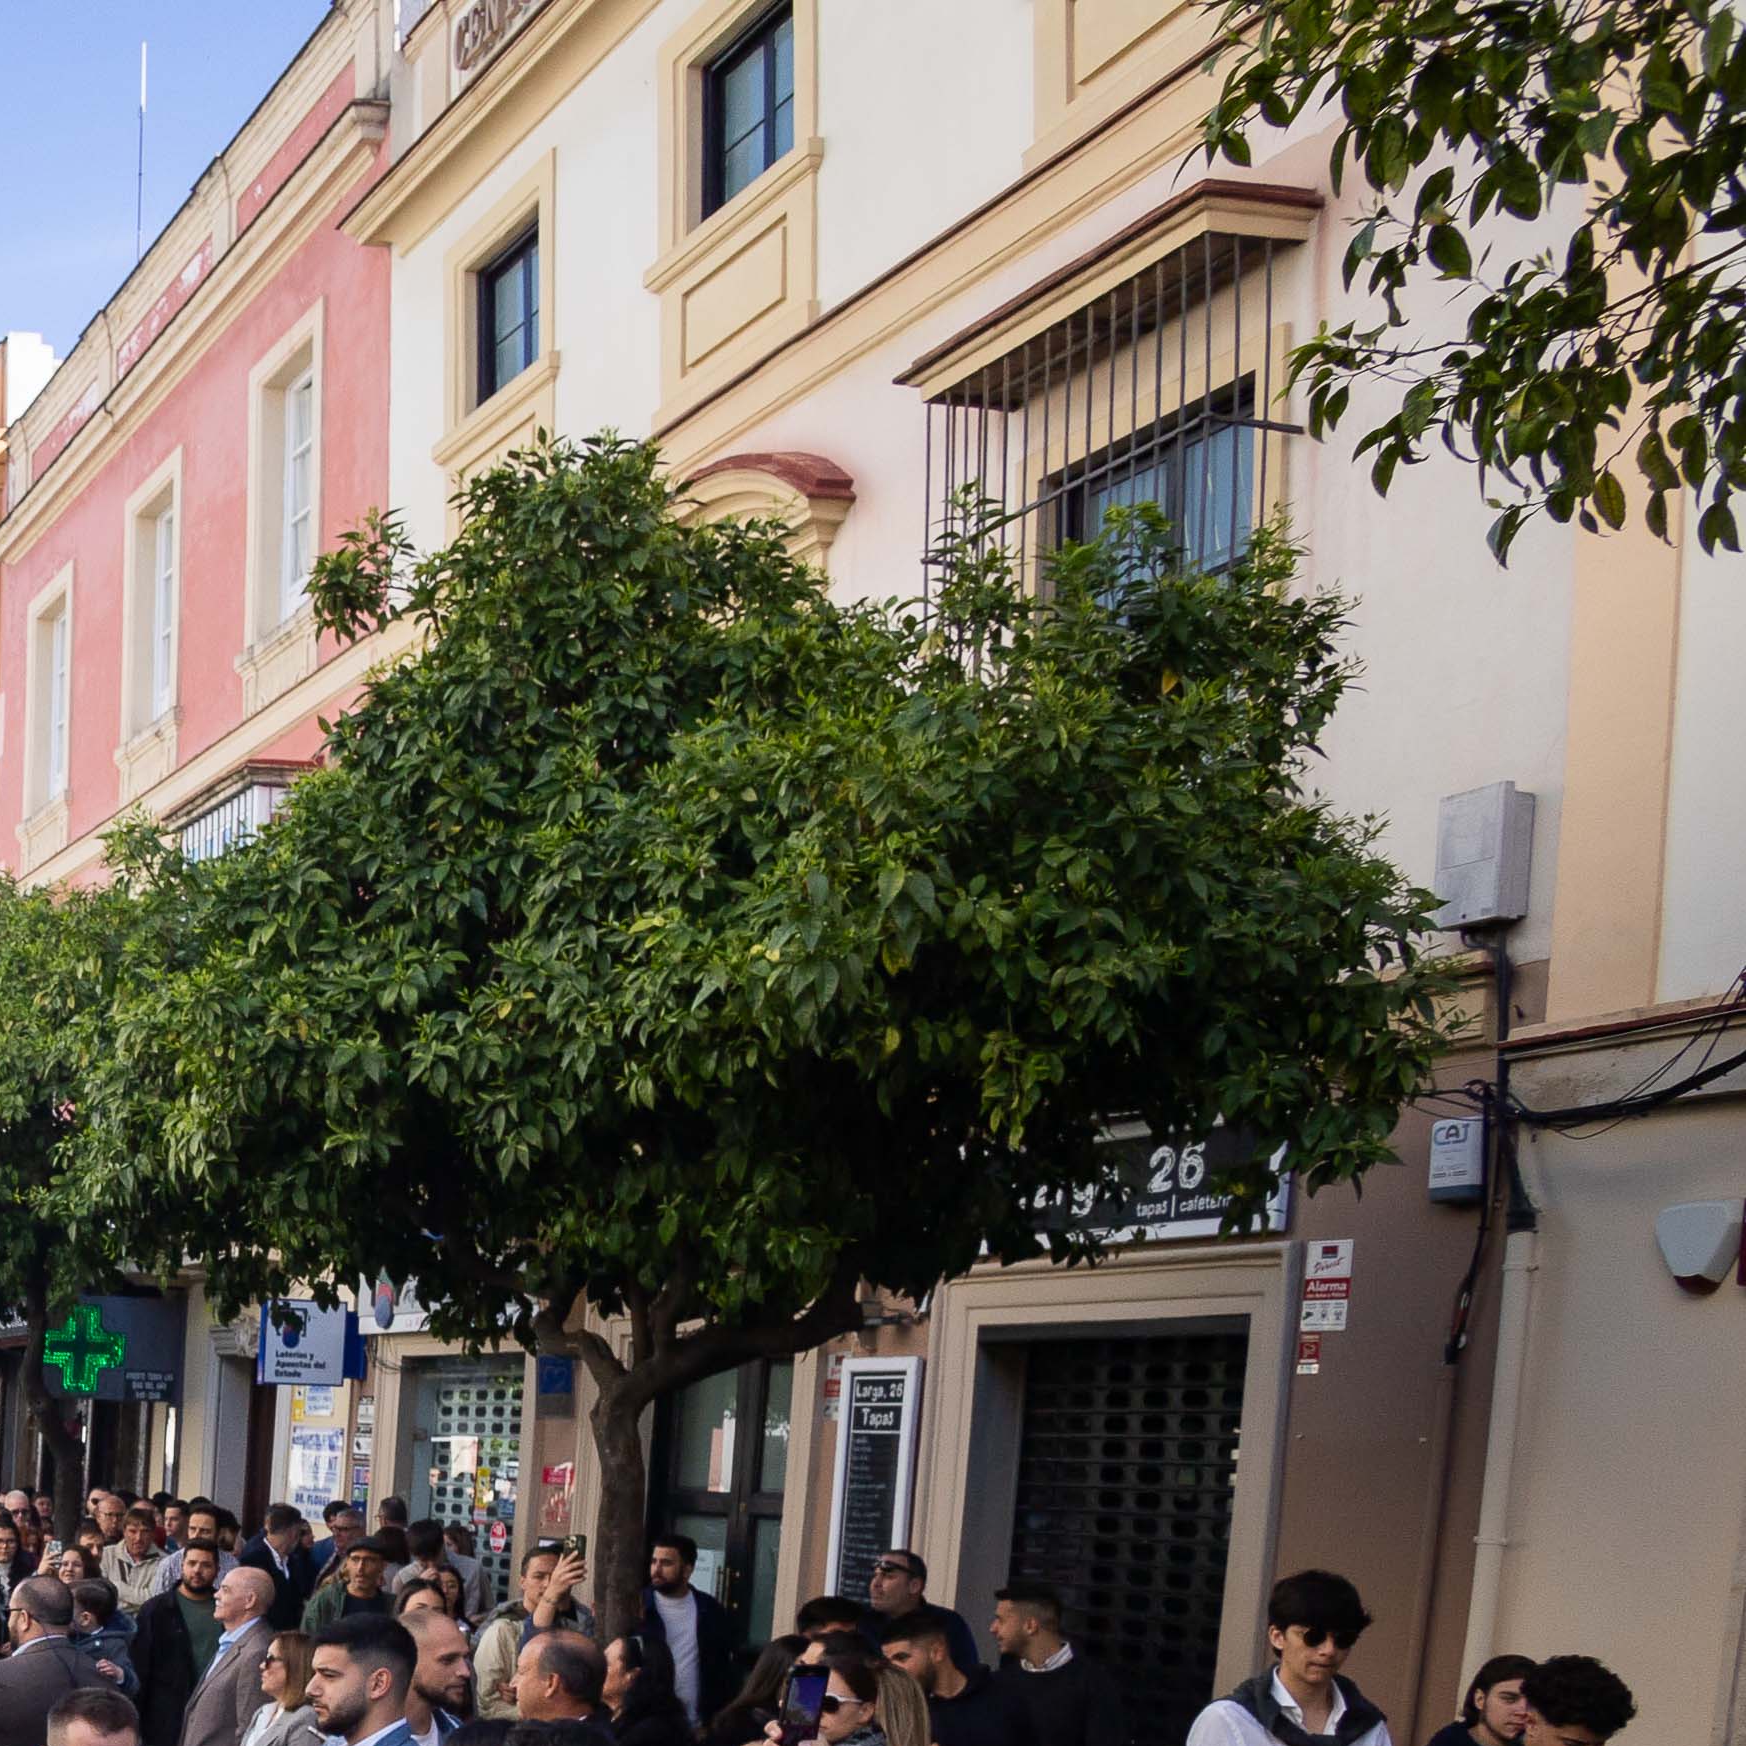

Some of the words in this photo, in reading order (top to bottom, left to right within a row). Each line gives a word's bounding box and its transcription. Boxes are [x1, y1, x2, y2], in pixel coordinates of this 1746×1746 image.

[1146, 1141, 1207, 1194] 26
[1135, 1198, 1169, 1218] tapas
[1306, 1280, 1347, 1293] Alarma
[855, 1382, 887, 1402] Larga,
[889, 1382, 904, 1397] 26
[862, 1407, 894, 1429] Tapas
